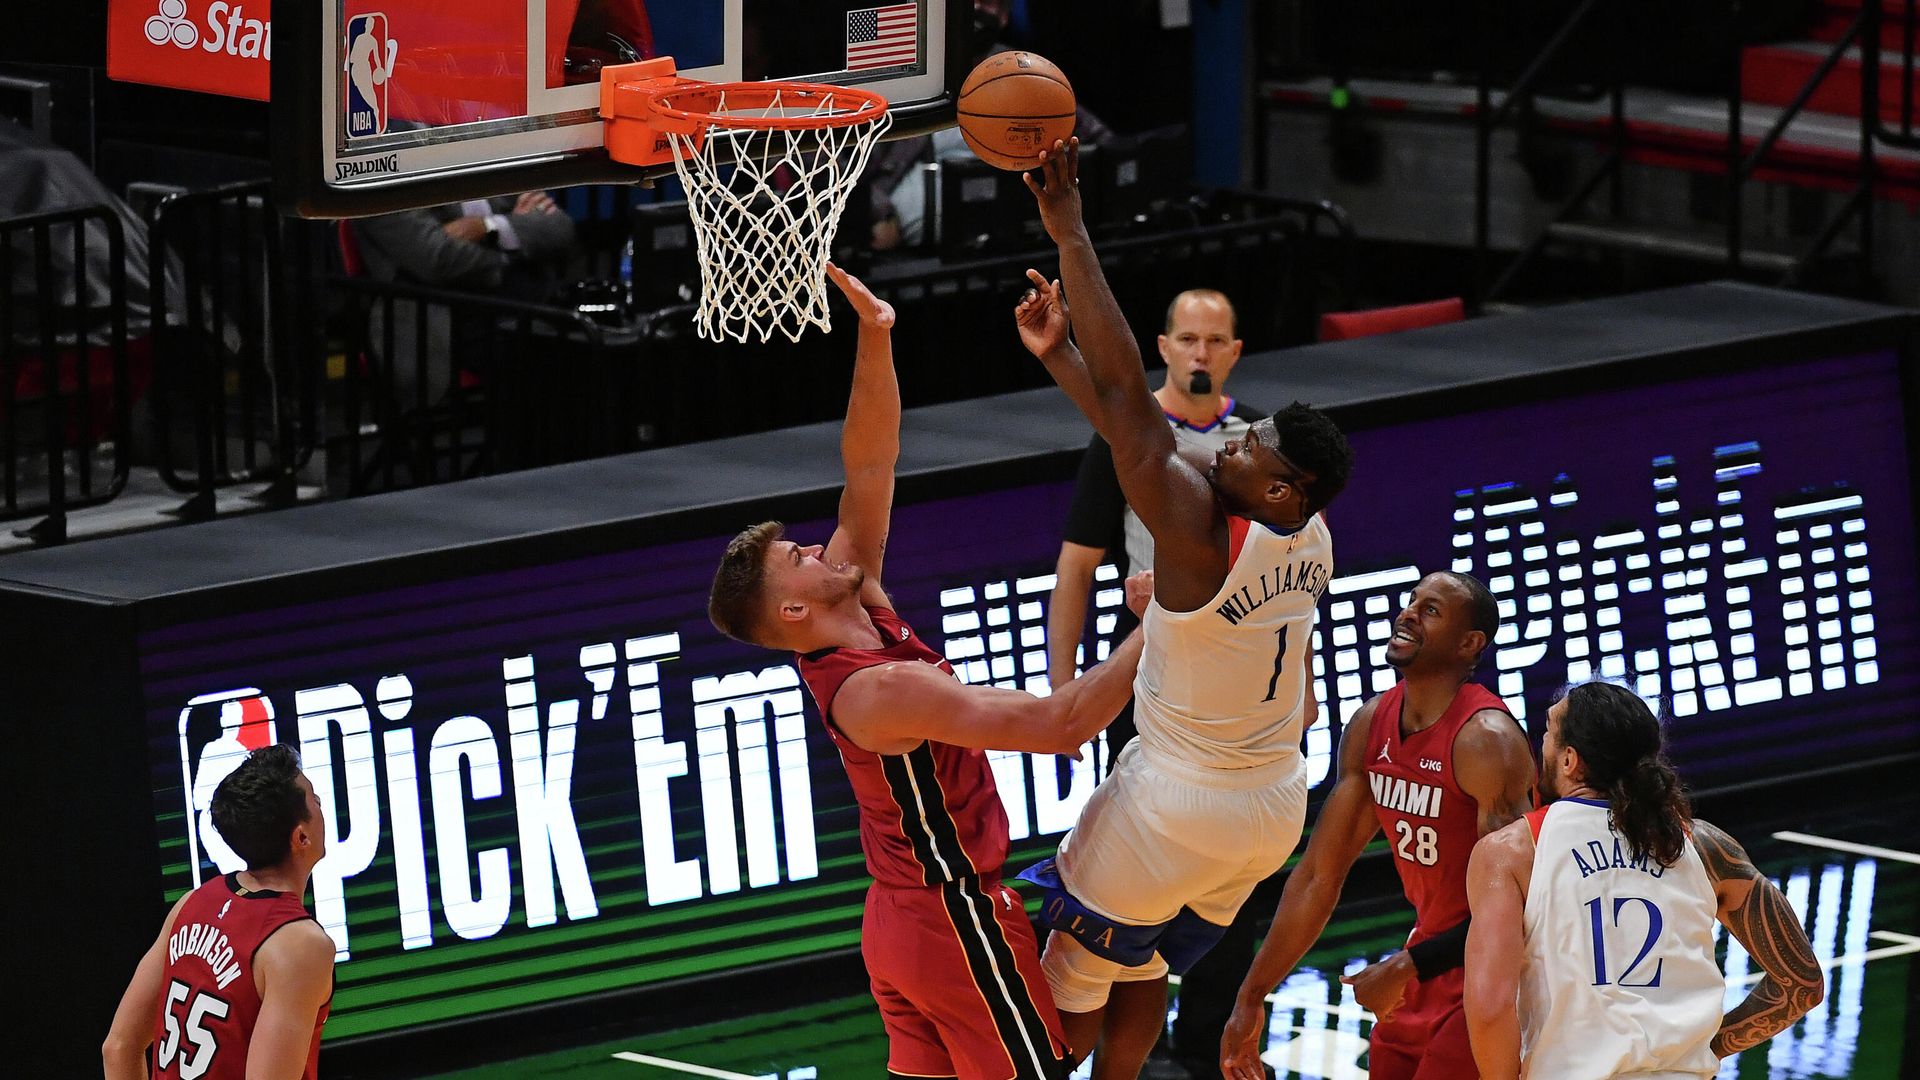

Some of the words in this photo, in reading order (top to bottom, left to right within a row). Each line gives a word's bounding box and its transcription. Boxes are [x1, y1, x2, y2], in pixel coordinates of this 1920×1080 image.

[352, 111, 372, 132] NBA
[335, 153, 399, 181] SPALDING
[1261, 623, 1289, 703] 1
[1419, 758, 1443, 772] UKG
[1368, 771, 1444, 819] MIAMI
[1395, 819, 1440, 867] 28
[169, 923, 242, 991] ROBINSON
[1584, 896, 1663, 988] 12
[157, 976, 231, 1080] 55
